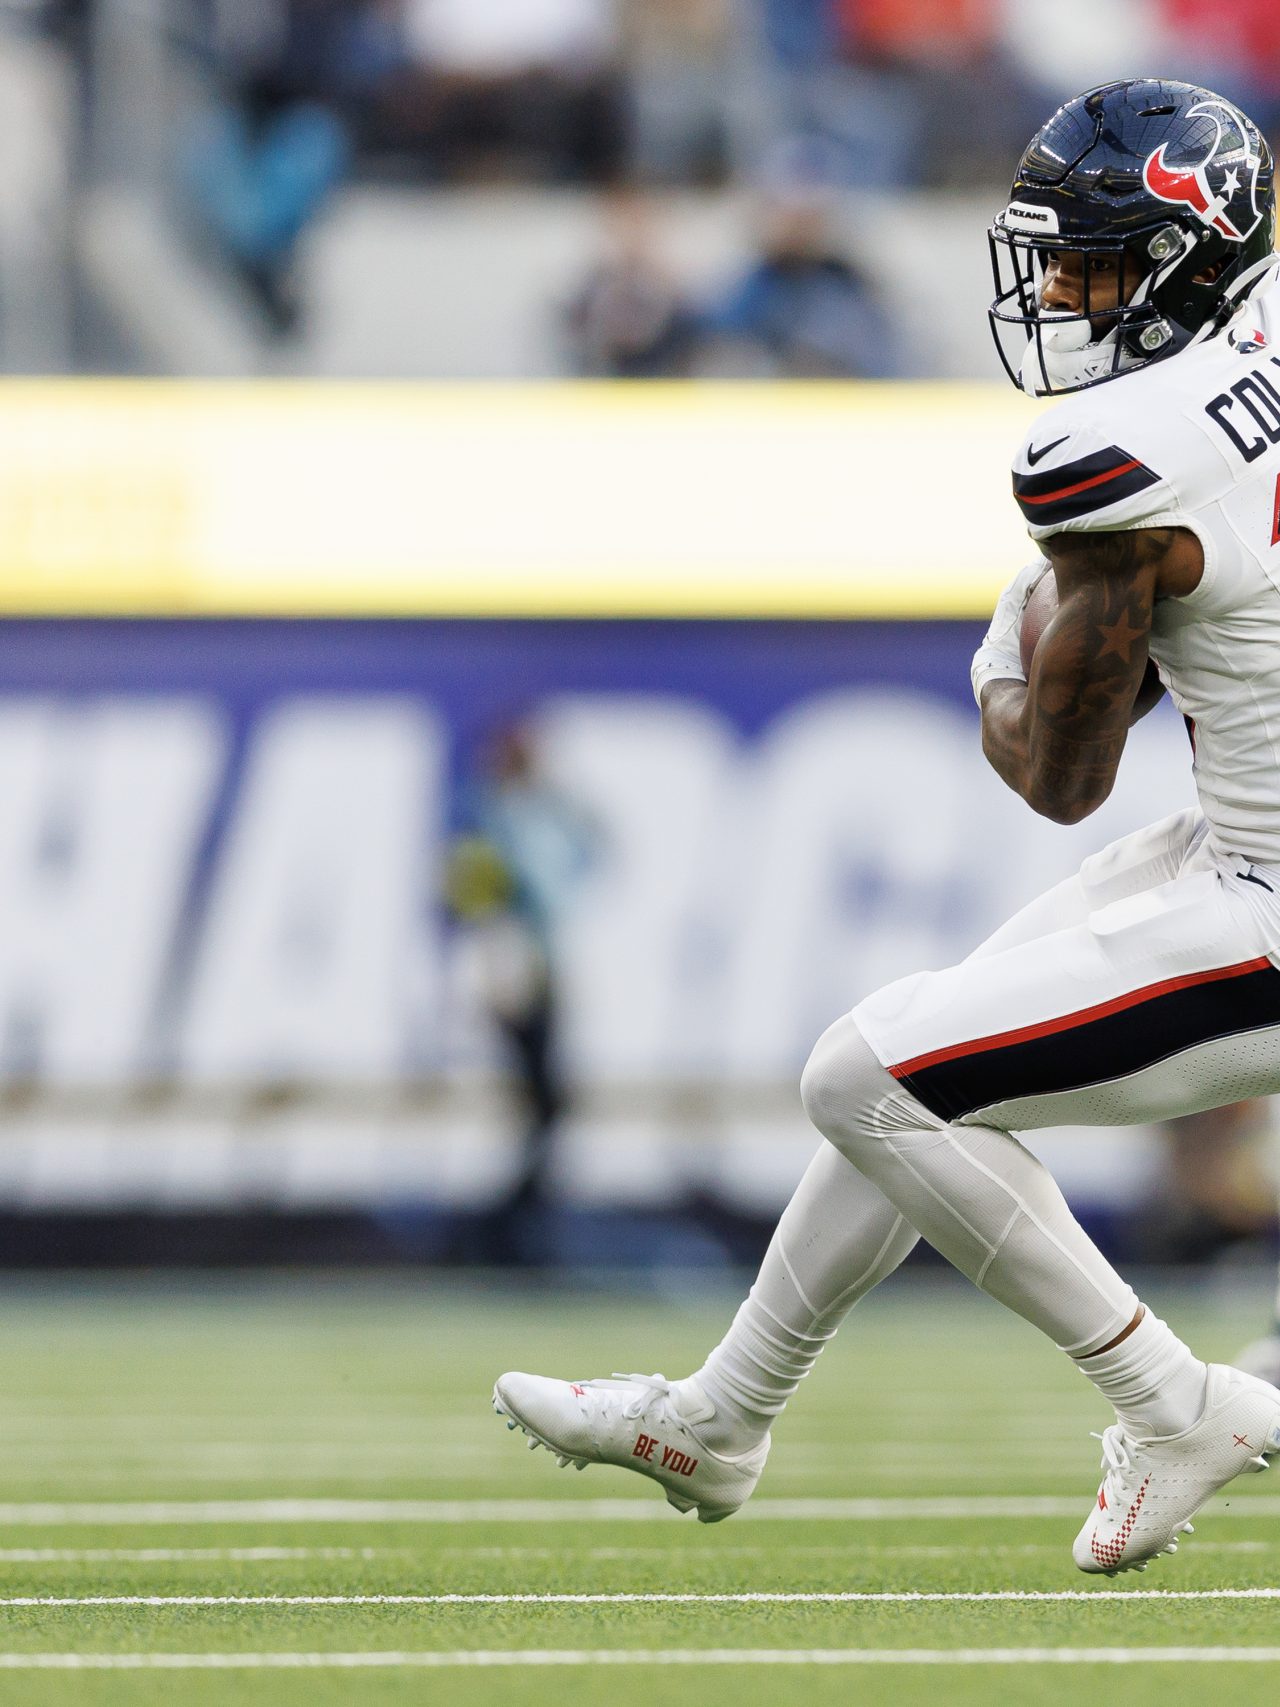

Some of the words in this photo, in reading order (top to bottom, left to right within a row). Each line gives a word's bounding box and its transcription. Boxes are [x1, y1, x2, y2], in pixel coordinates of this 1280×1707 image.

[1009, 208, 1048, 221] TEXANS
[632, 1433, 659, 1462] BE
[661, 1445, 698, 1477] YOU
